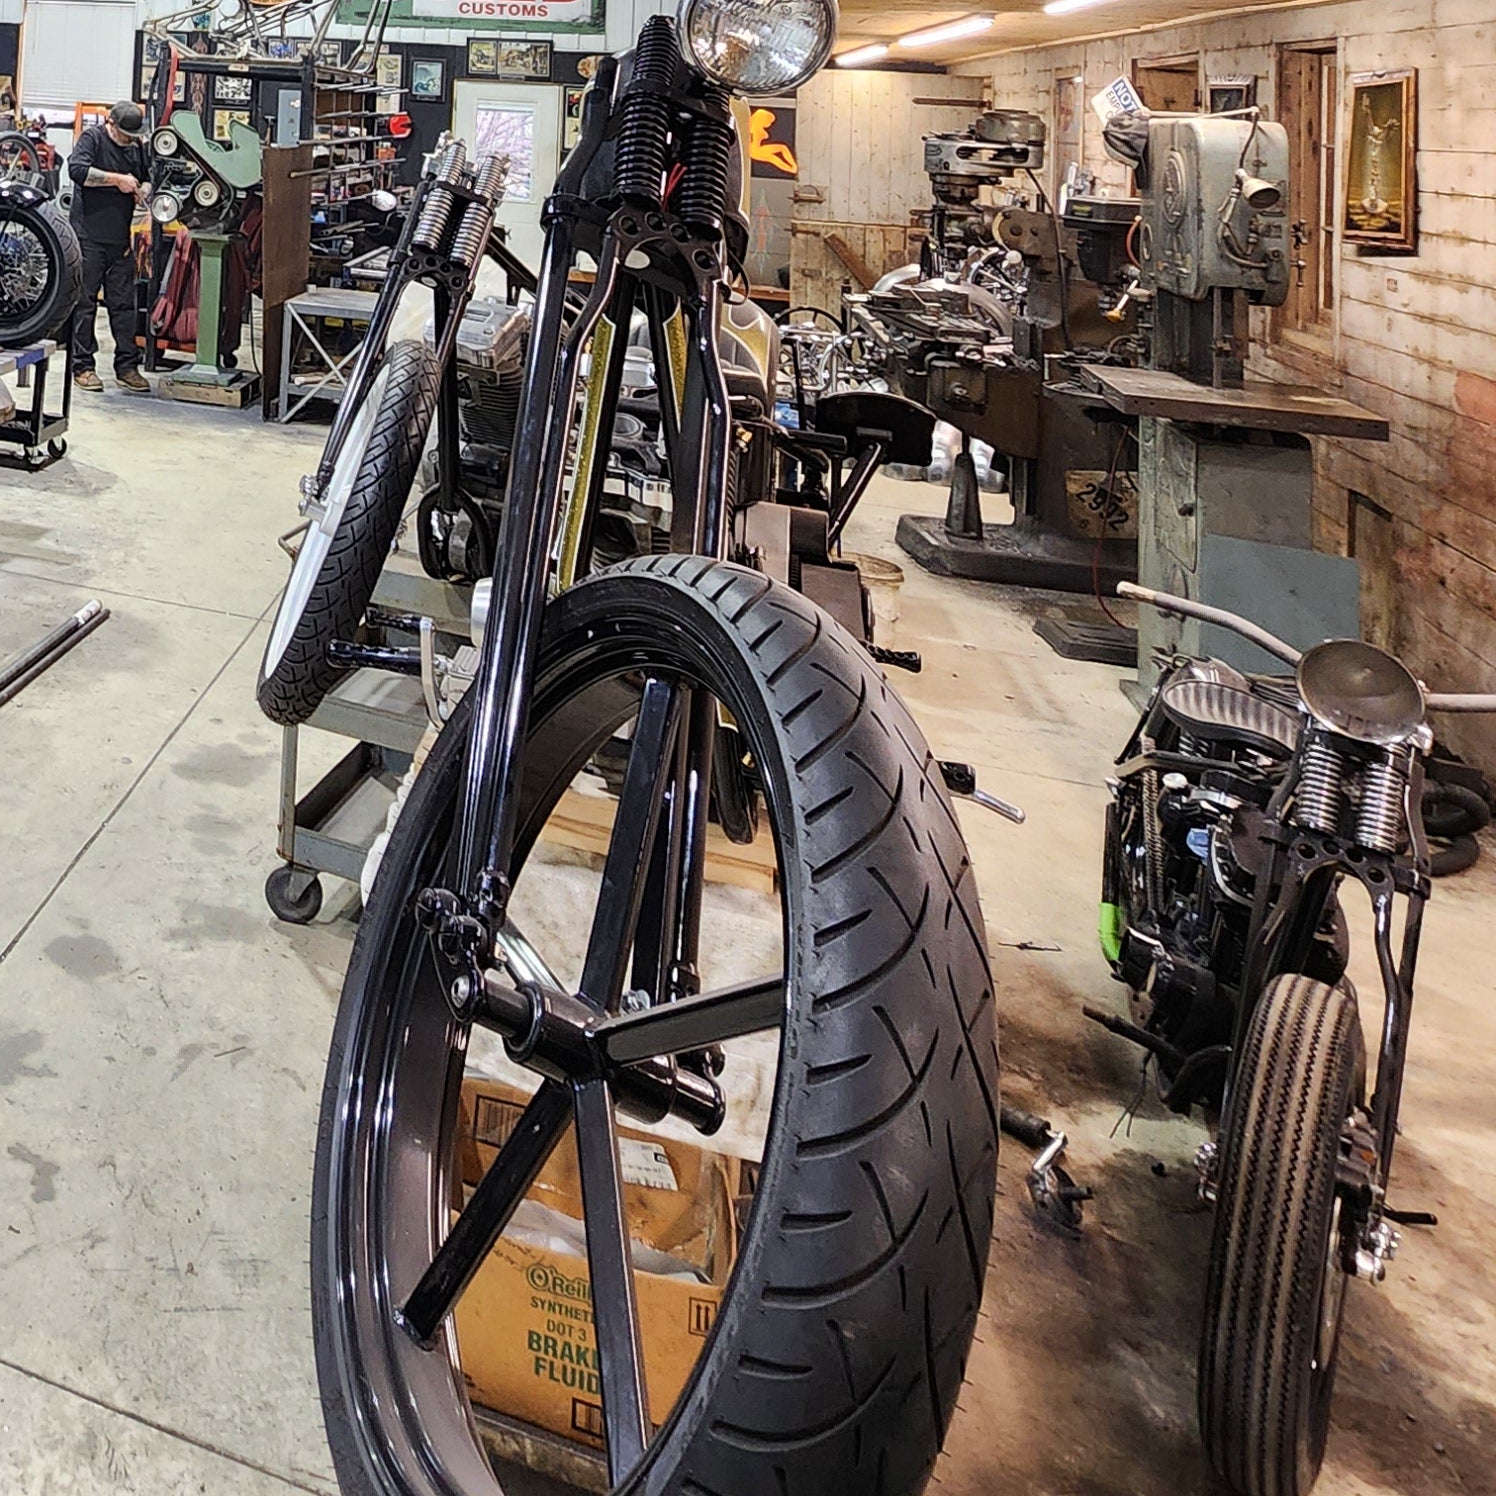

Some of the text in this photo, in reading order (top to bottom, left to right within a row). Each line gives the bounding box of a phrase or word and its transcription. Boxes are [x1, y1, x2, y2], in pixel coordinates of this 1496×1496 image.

[458, 2, 549, 17] CUSTOMS
[527, 1265, 592, 1301] O'Reill
[547, 1319, 587, 1342] DOT 3
